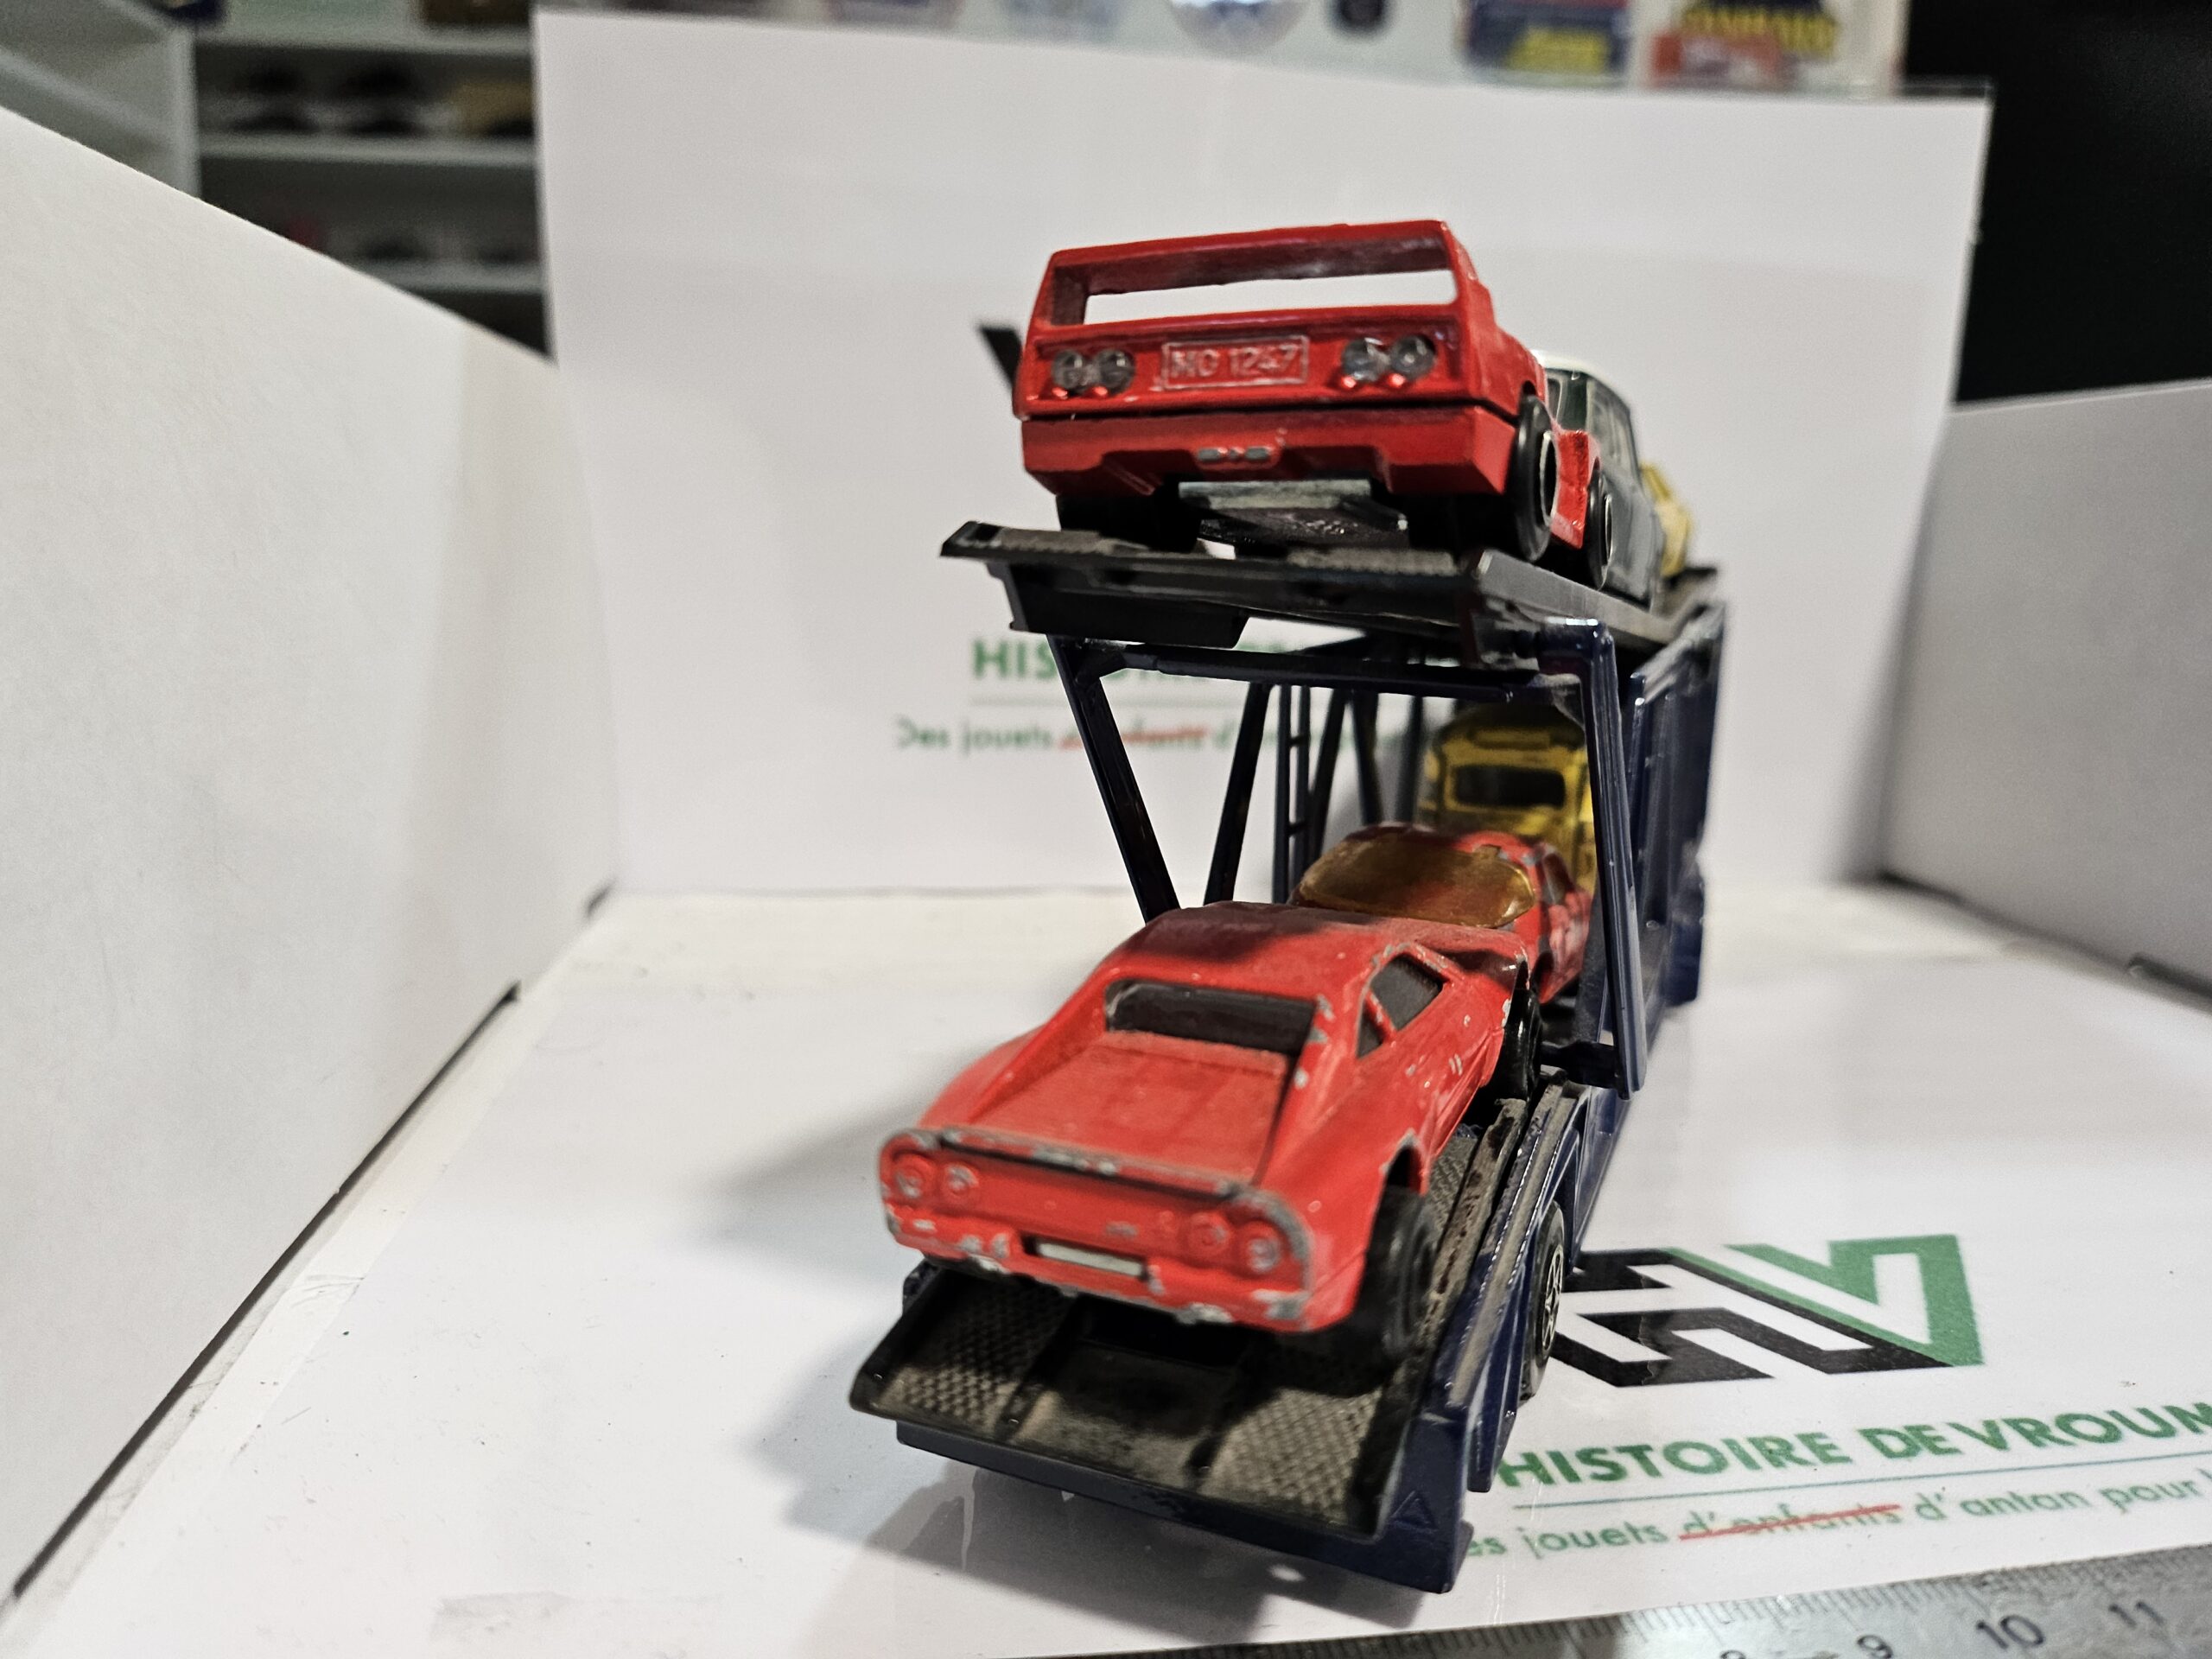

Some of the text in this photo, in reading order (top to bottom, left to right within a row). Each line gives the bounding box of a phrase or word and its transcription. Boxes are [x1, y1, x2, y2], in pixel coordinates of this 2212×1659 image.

[1497, 1432, 1853, 1487] HISTOIRE
[1516, 1520, 1668, 1560] jouets
[2100, 1479, 2201, 1514] pour
[1974, 1613, 2044, 1650] 10
[2108, 1600, 2164, 1629] 11
